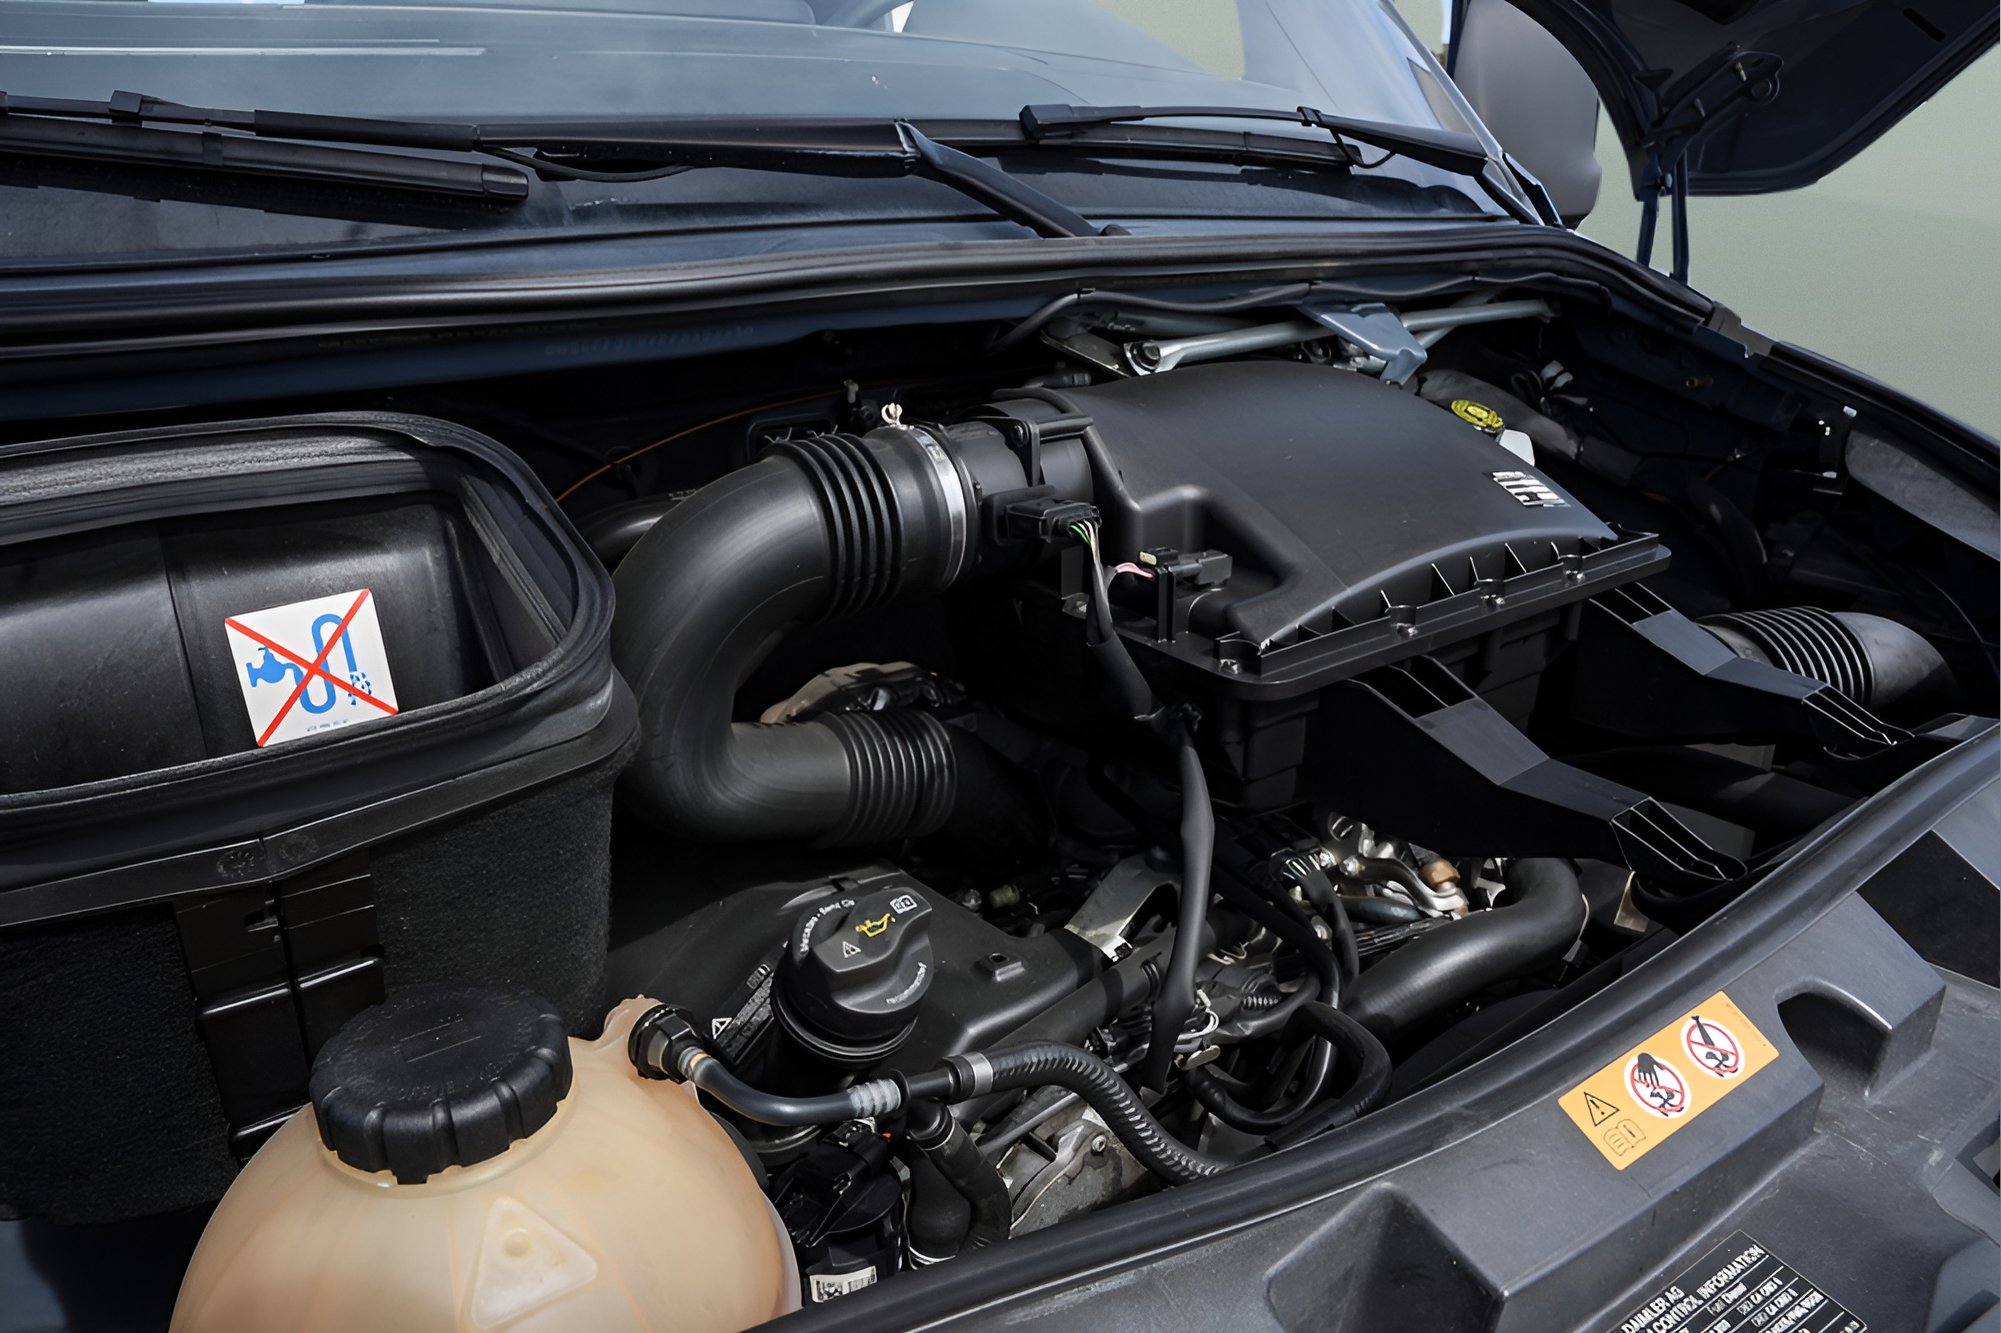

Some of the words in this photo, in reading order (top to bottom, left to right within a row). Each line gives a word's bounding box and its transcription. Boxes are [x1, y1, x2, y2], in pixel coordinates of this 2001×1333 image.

[1621, 1297, 1670, 1333] DAIMLER
[1665, 1286, 1685, 1304] AG
[1652, 1295, 1703, 1333] CONTROL
[1696, 1244, 1765, 1299] INFORMATION
